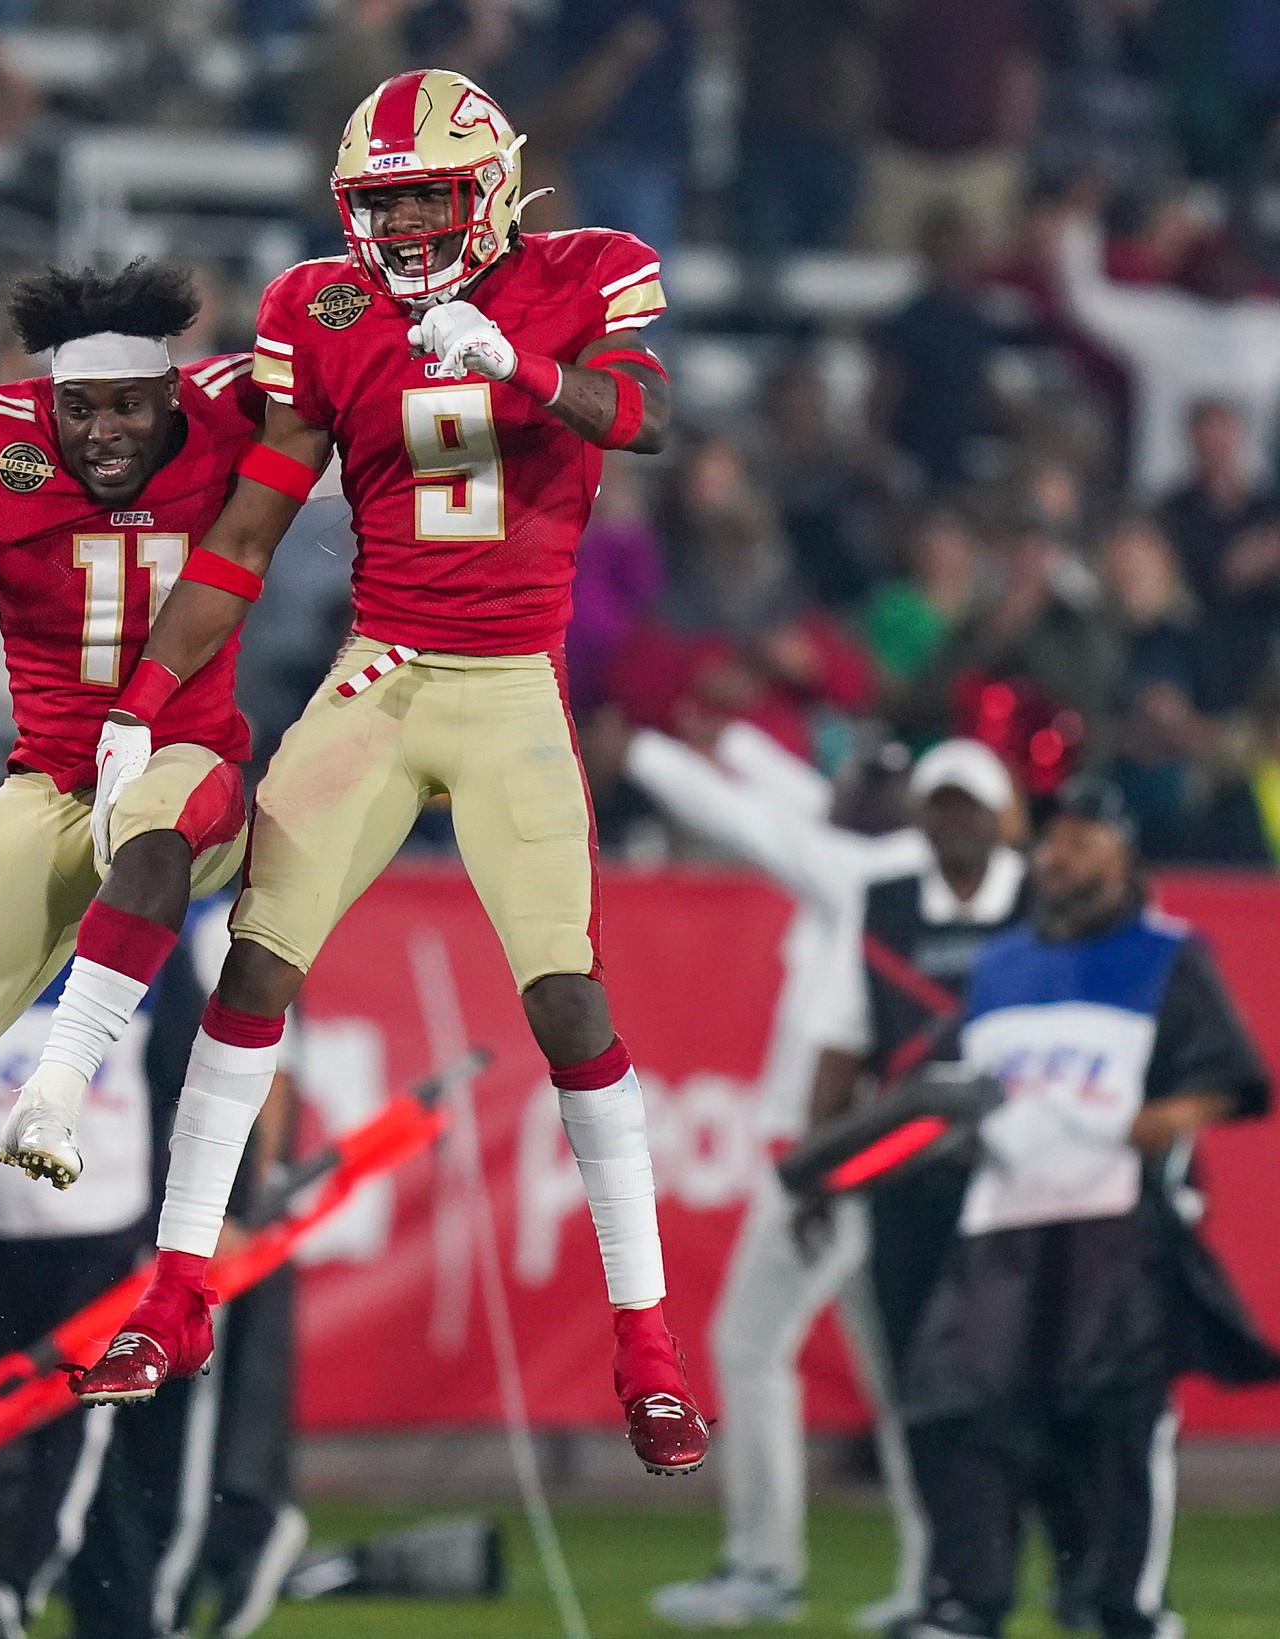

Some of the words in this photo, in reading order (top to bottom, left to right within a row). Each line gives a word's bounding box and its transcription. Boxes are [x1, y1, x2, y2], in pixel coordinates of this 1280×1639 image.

[372, 156, 411, 170] USFL
[324, 298, 358, 311] USFL
[5, 459, 40, 473] USFL
[402, 382, 506, 541] 9
[111, 512, 153, 525] USFL
[73, 532, 189, 688] 11
